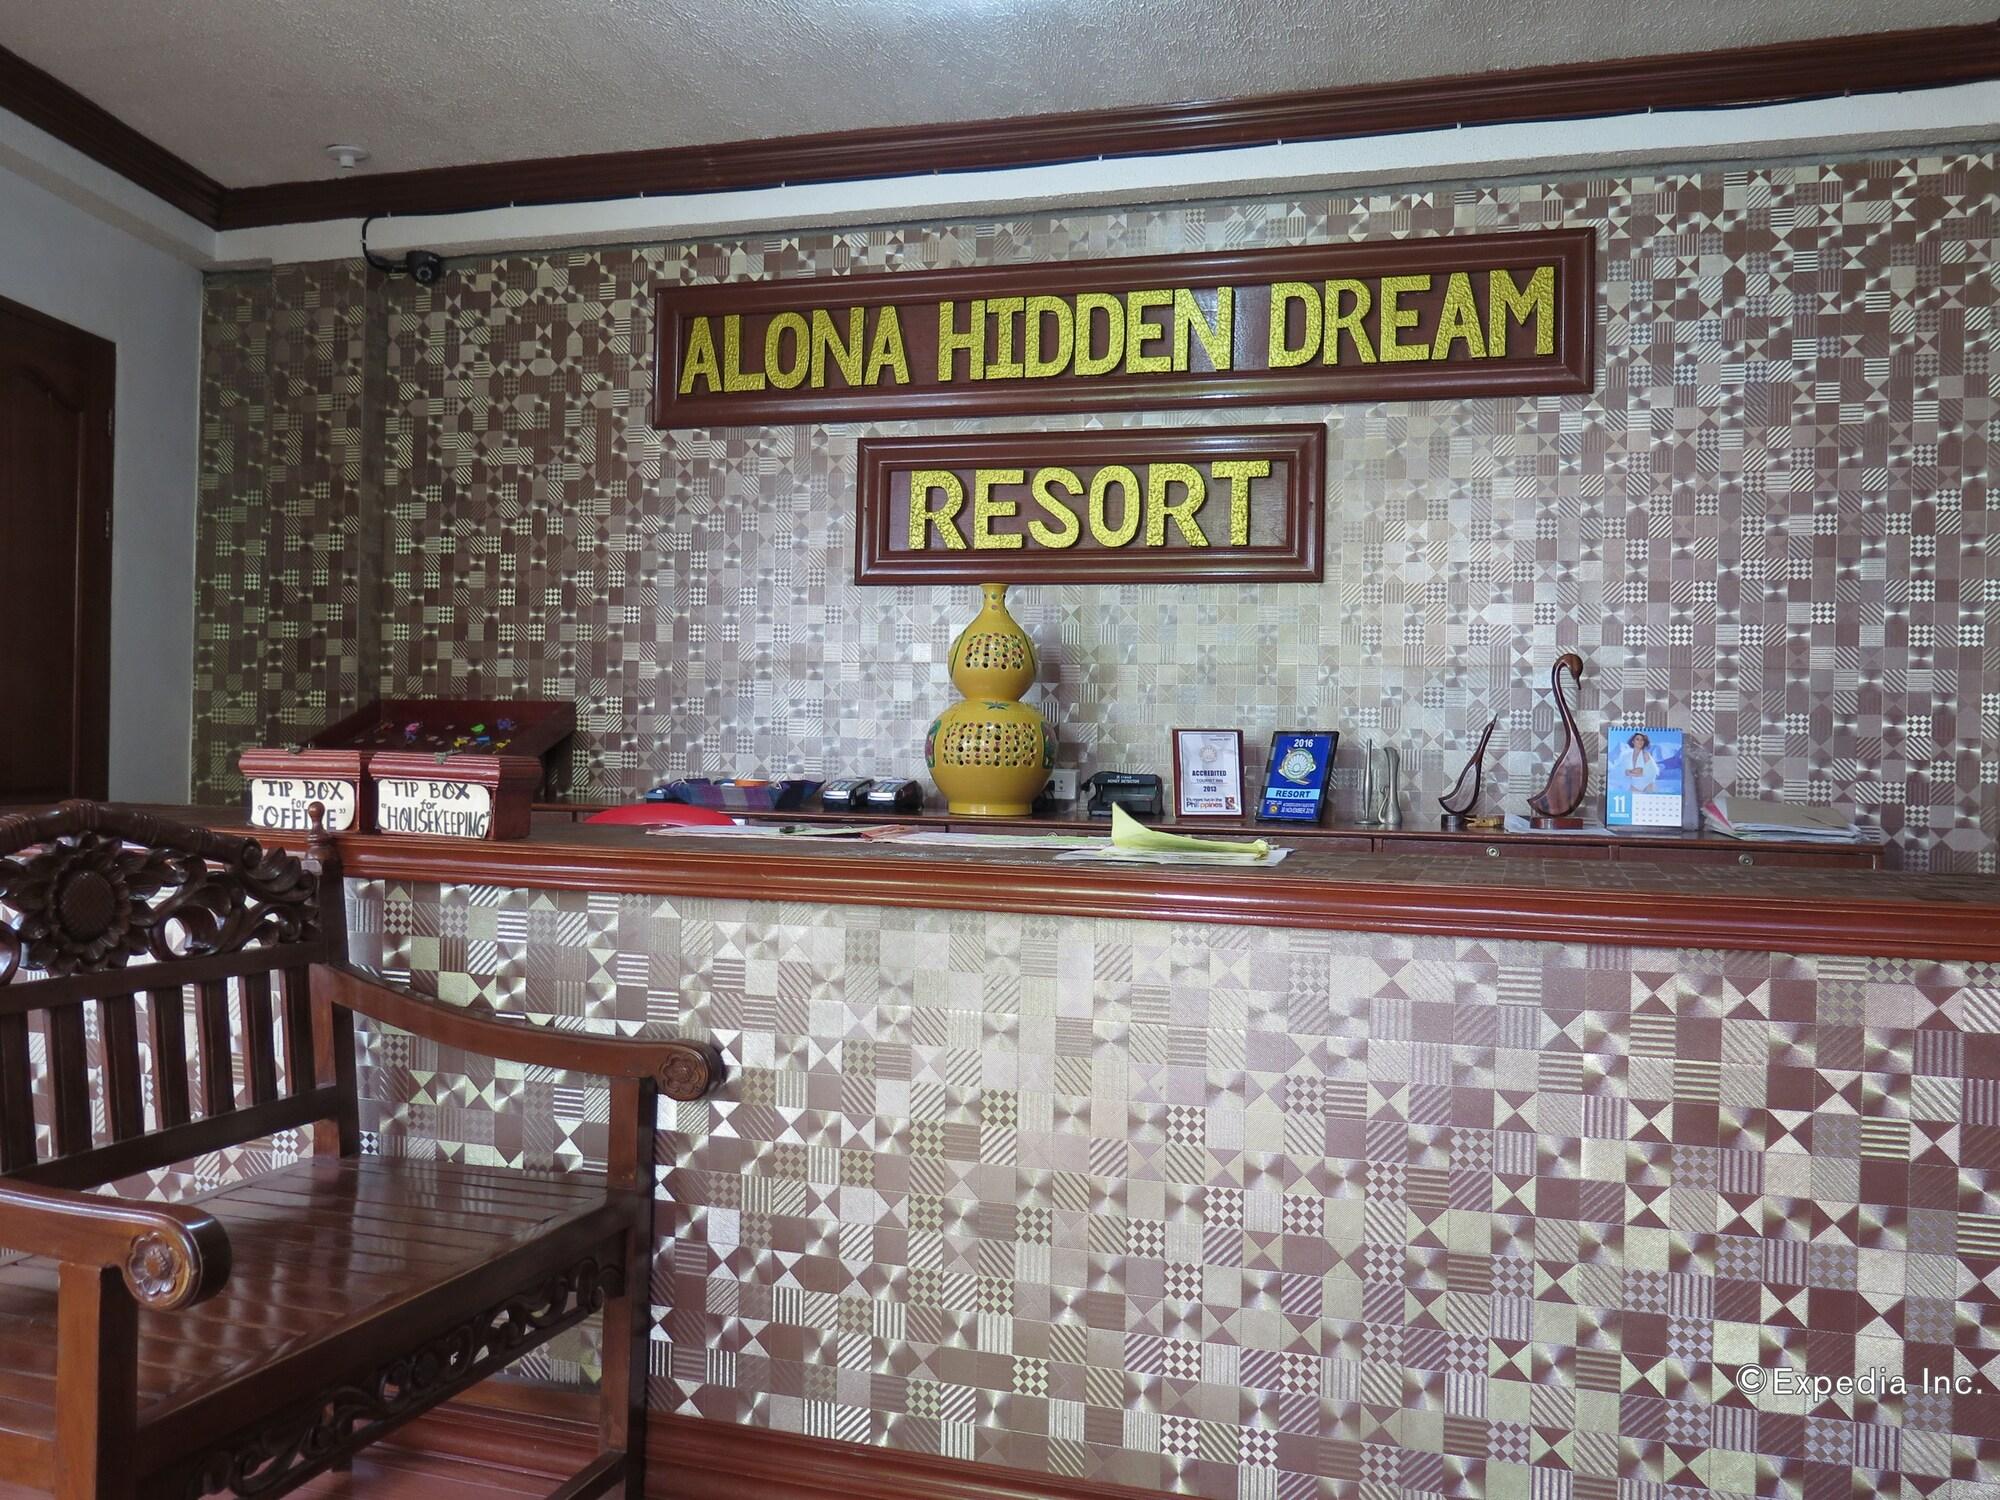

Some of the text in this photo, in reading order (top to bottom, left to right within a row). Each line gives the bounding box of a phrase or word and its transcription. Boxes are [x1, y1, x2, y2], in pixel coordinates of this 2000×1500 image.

[679, 266, 1555, 394] ALONA HIDDEN DREAM
[908, 460, 1270, 550] RESORT
[1293, 738, 1314, 748] 2016
[262, 780, 344, 800] TIP BOX
[388, 780, 470, 800] TIP BOX
[1276, 790, 1311, 798] RESORT
[291, 798, 306, 809] for
[420, 799, 437, 810] for
[1613, 795, 1626, 813] 11
[258, 804, 346, 832] "OFFIE"
